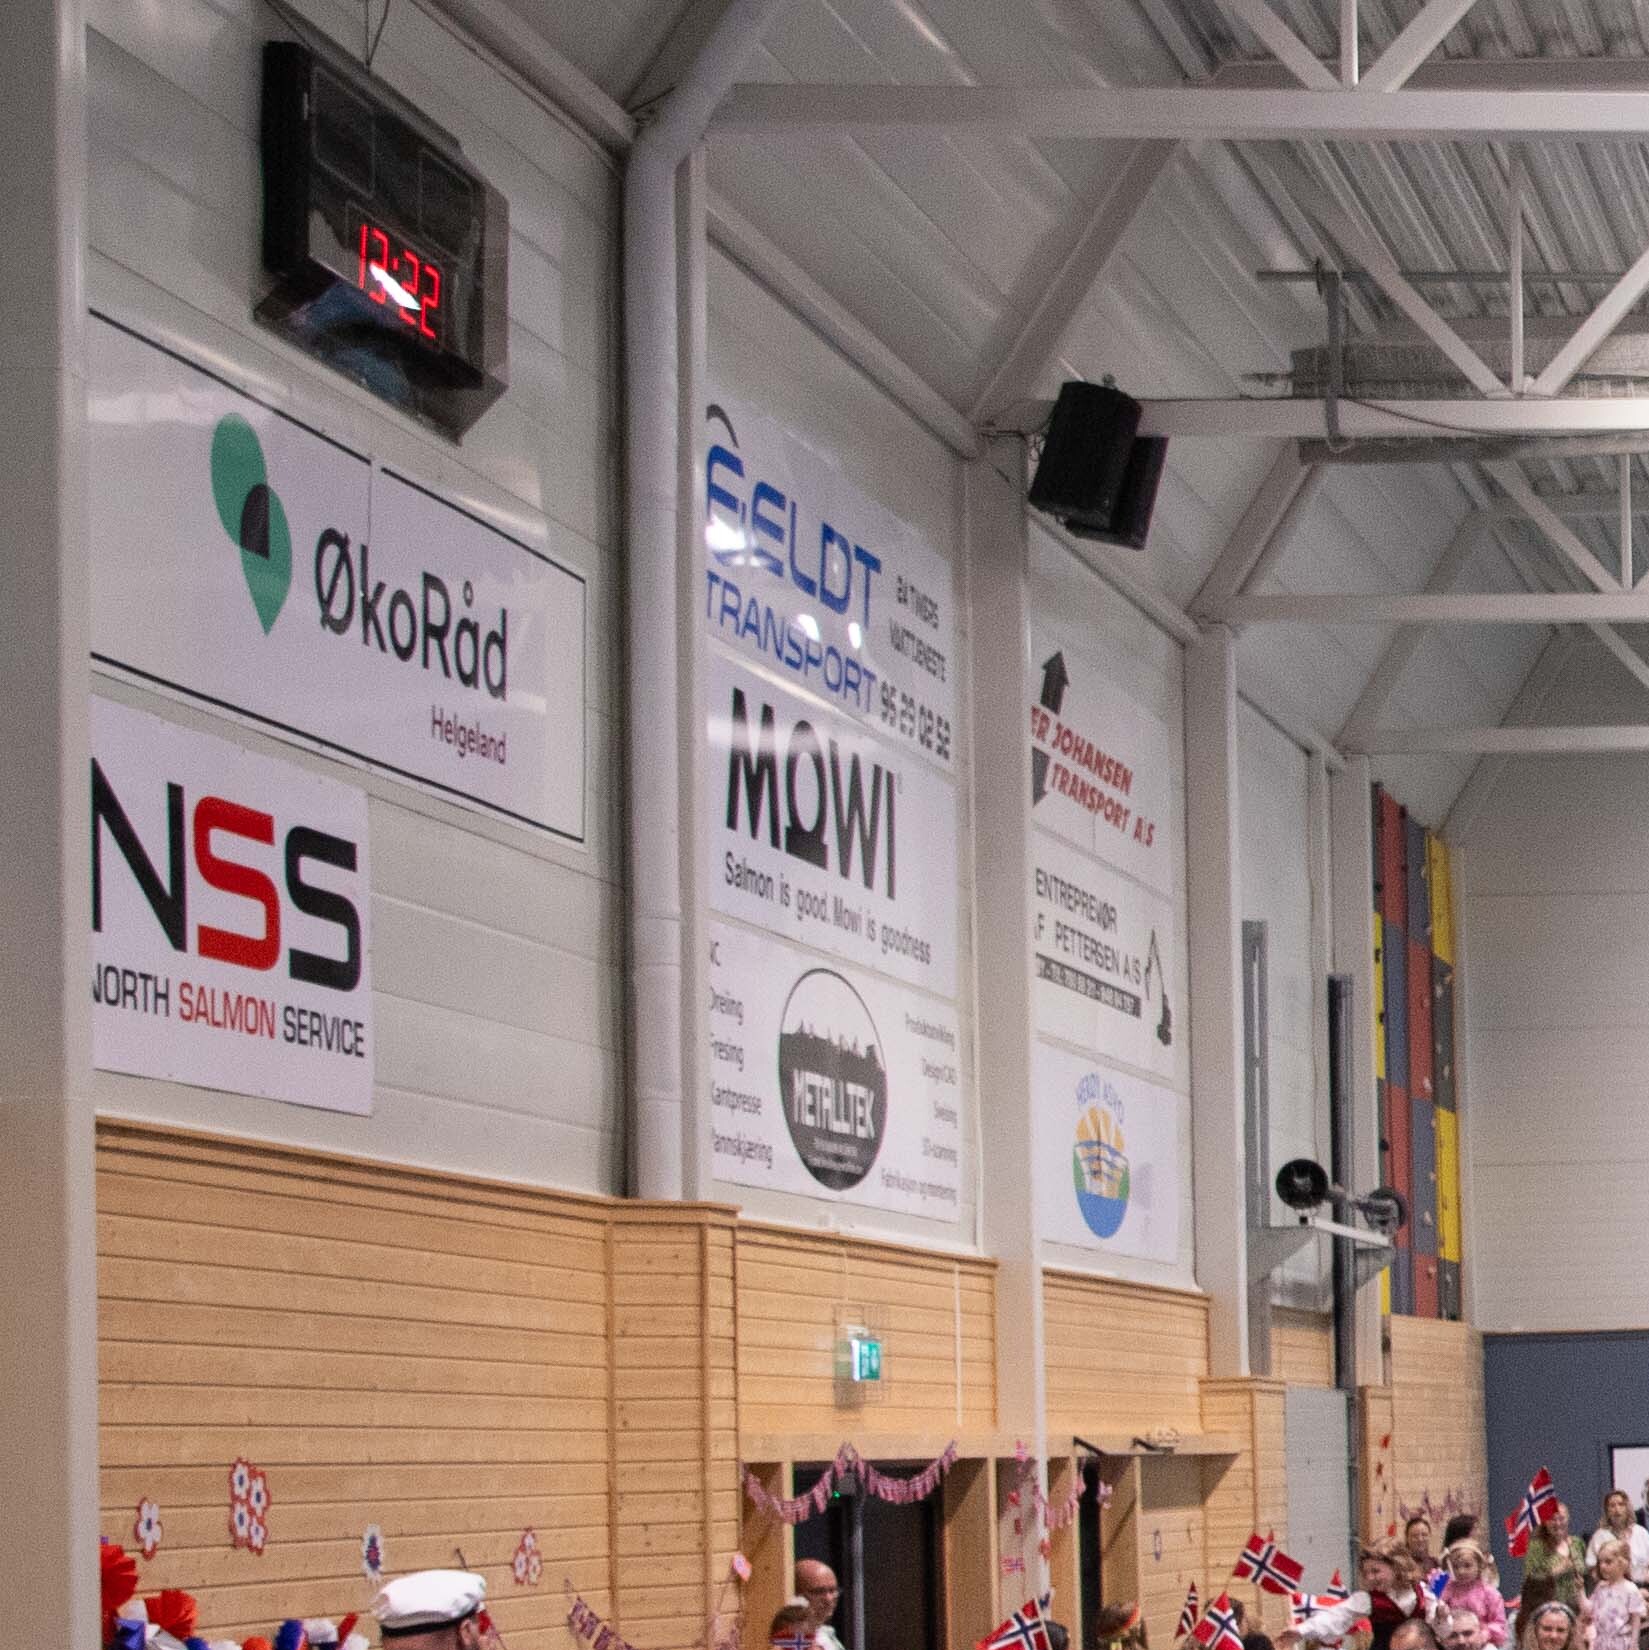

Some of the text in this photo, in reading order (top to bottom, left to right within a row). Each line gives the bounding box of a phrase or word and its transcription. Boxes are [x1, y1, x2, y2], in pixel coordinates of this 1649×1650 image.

[315, 527, 509, 702] ØkoRåd
[706, 569, 877, 712] TRANSPORT
[431, 706, 508, 765] Helgeland
[1051, 721, 1133, 796] JOHANSEN
[725, 686, 896, 901] MOWI
[1051, 762, 1131, 833] TRANSPORT
[91, 757, 361, 992] NSS
[724, 850, 774, 901] Salmon
[779, 873, 790, 907] is
[1055, 920, 1120, 976] PETTERSEN
[179, 982, 276, 1040] SALMON
[283, 1006, 364, 1058] SERVICE
